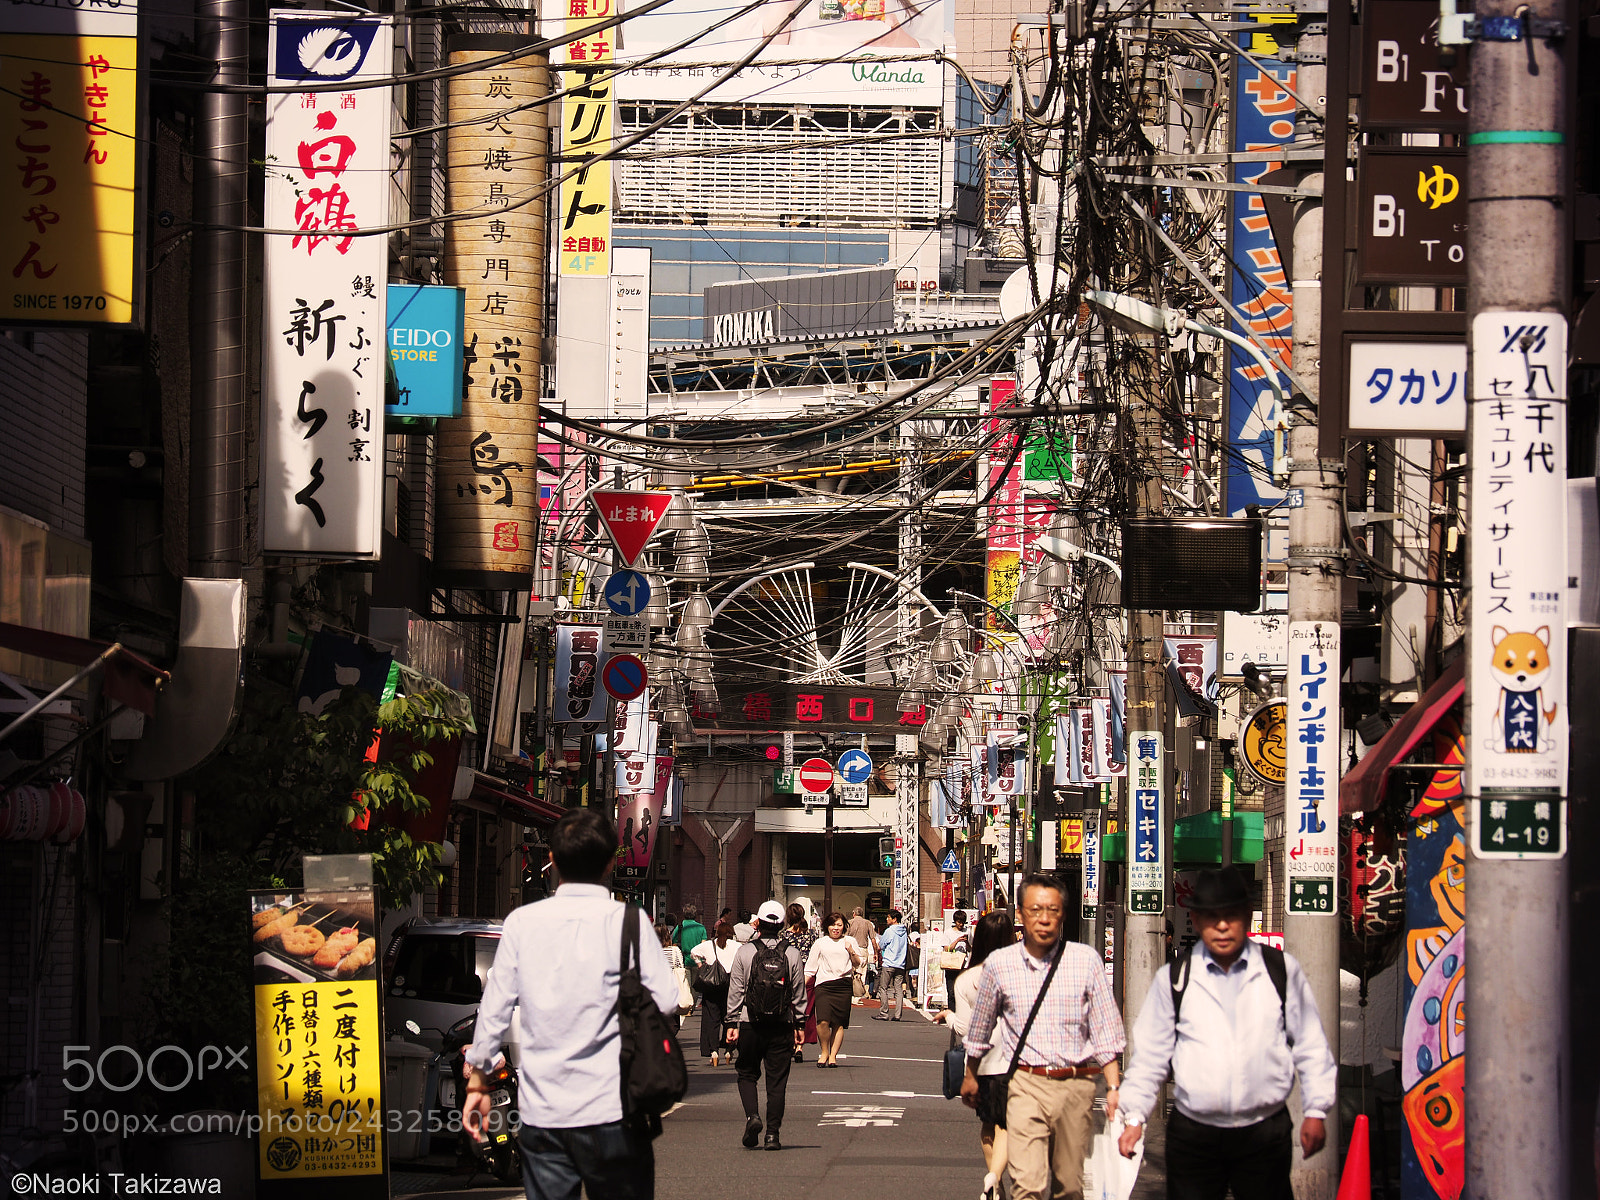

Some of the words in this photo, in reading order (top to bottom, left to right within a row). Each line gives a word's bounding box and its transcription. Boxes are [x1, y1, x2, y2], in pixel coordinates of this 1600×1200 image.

[1376, 40, 1409, 83] B1
[84, 54, 110, 166] やきとん
[300, 92, 357, 110] 清酒
[564, 68, 610, 230] エリート
[12, 71, 60, 280] まこちゃん
[291, 110, 360, 257] 白鶴
[1417, 165, 1459, 209] ゆ
[481, 74, 514, 316] 炭火焼鳥専門店
[1373, 194, 1405, 237] B1
[563, 236, 606, 254] 全自動
[569, 256, 596, 271] 4F
[13, 294, 57, 310] SINCE
[62, 295, 107, 311] 1970
[388, 328, 452, 348] EIDO
[713, 310, 774, 343] KONAKA
[1366, 368, 1468, 405] タカソ
[282, 297, 347, 529] 新らく
[1523, 364, 1555, 474] 八千代
[1288, 494, 1303, 506] 65
[1487, 378, 1514, 614] セキュリティサービス
[608, 505, 656, 523] 止まれ
[607, 620, 647, 630] 自転車を除く
[607, 632, 646, 642] 一方通行
[1510, 694, 1535, 748] 八千代
[1135, 738, 1159, 762] 質
[1299, 654, 1328, 834] レインボーホテル
[777, 772, 791, 786] JR
[1489, 800, 1550, 821] 新橋
[1138, 791, 1157, 861] セキネ
[1491, 826, 1550, 846] 4-19
[626, 867, 638, 876] B1
[1288, 861, 1335, 873] 3433-0006
[1136, 902, 1158, 910] 4-19
[1295, 898, 1328, 910] 4-19
[333, 987, 361, 1095] 二度付け
[272, 989, 297, 1127] 手作りソース
[301, 989, 324, 1127] 日替り六種類の
[328, 1096, 375, 1125] OK!
[304, 1133, 376, 1154] 串かつ団
[304, 1154, 356, 1162] KUSHIKATSU
[304, 1160, 377, 1172] 03-6432-4293
